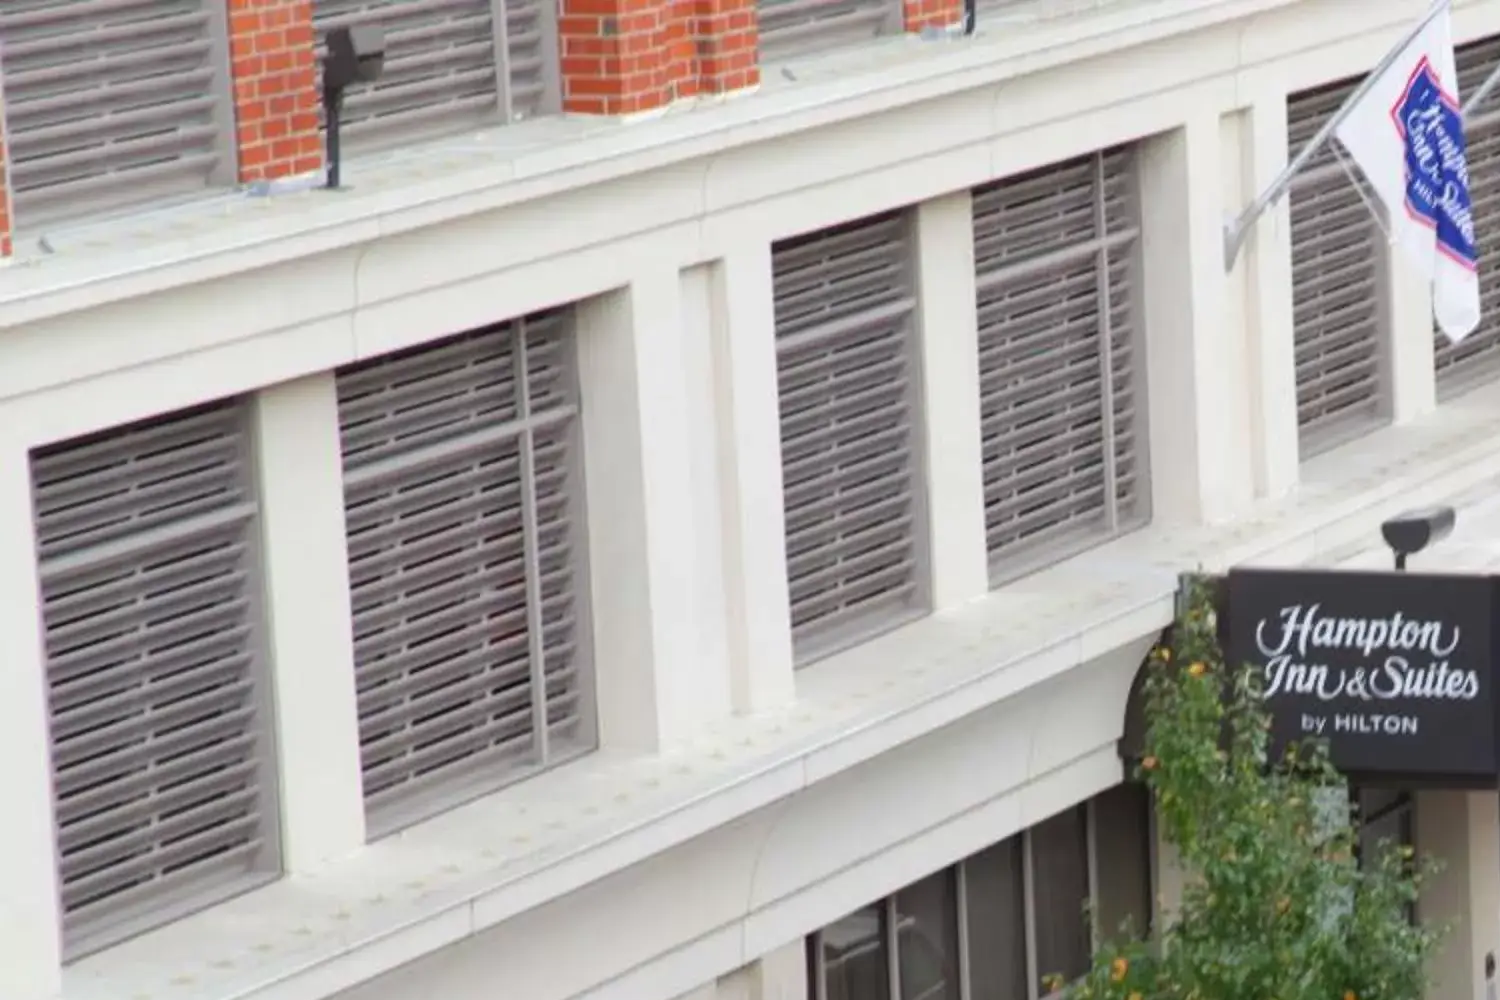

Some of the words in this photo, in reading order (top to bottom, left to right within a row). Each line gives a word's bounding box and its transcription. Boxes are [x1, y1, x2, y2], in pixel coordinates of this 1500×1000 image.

[1256, 602, 1460, 658] Hampton
[1248, 654, 1346, 700] Inn
[1345, 667, 1372, 701] &
[1369, 655, 1480, 700] Suites
[1301, 713, 1327, 734] by
[1334, 713, 1419, 735] HILTON
